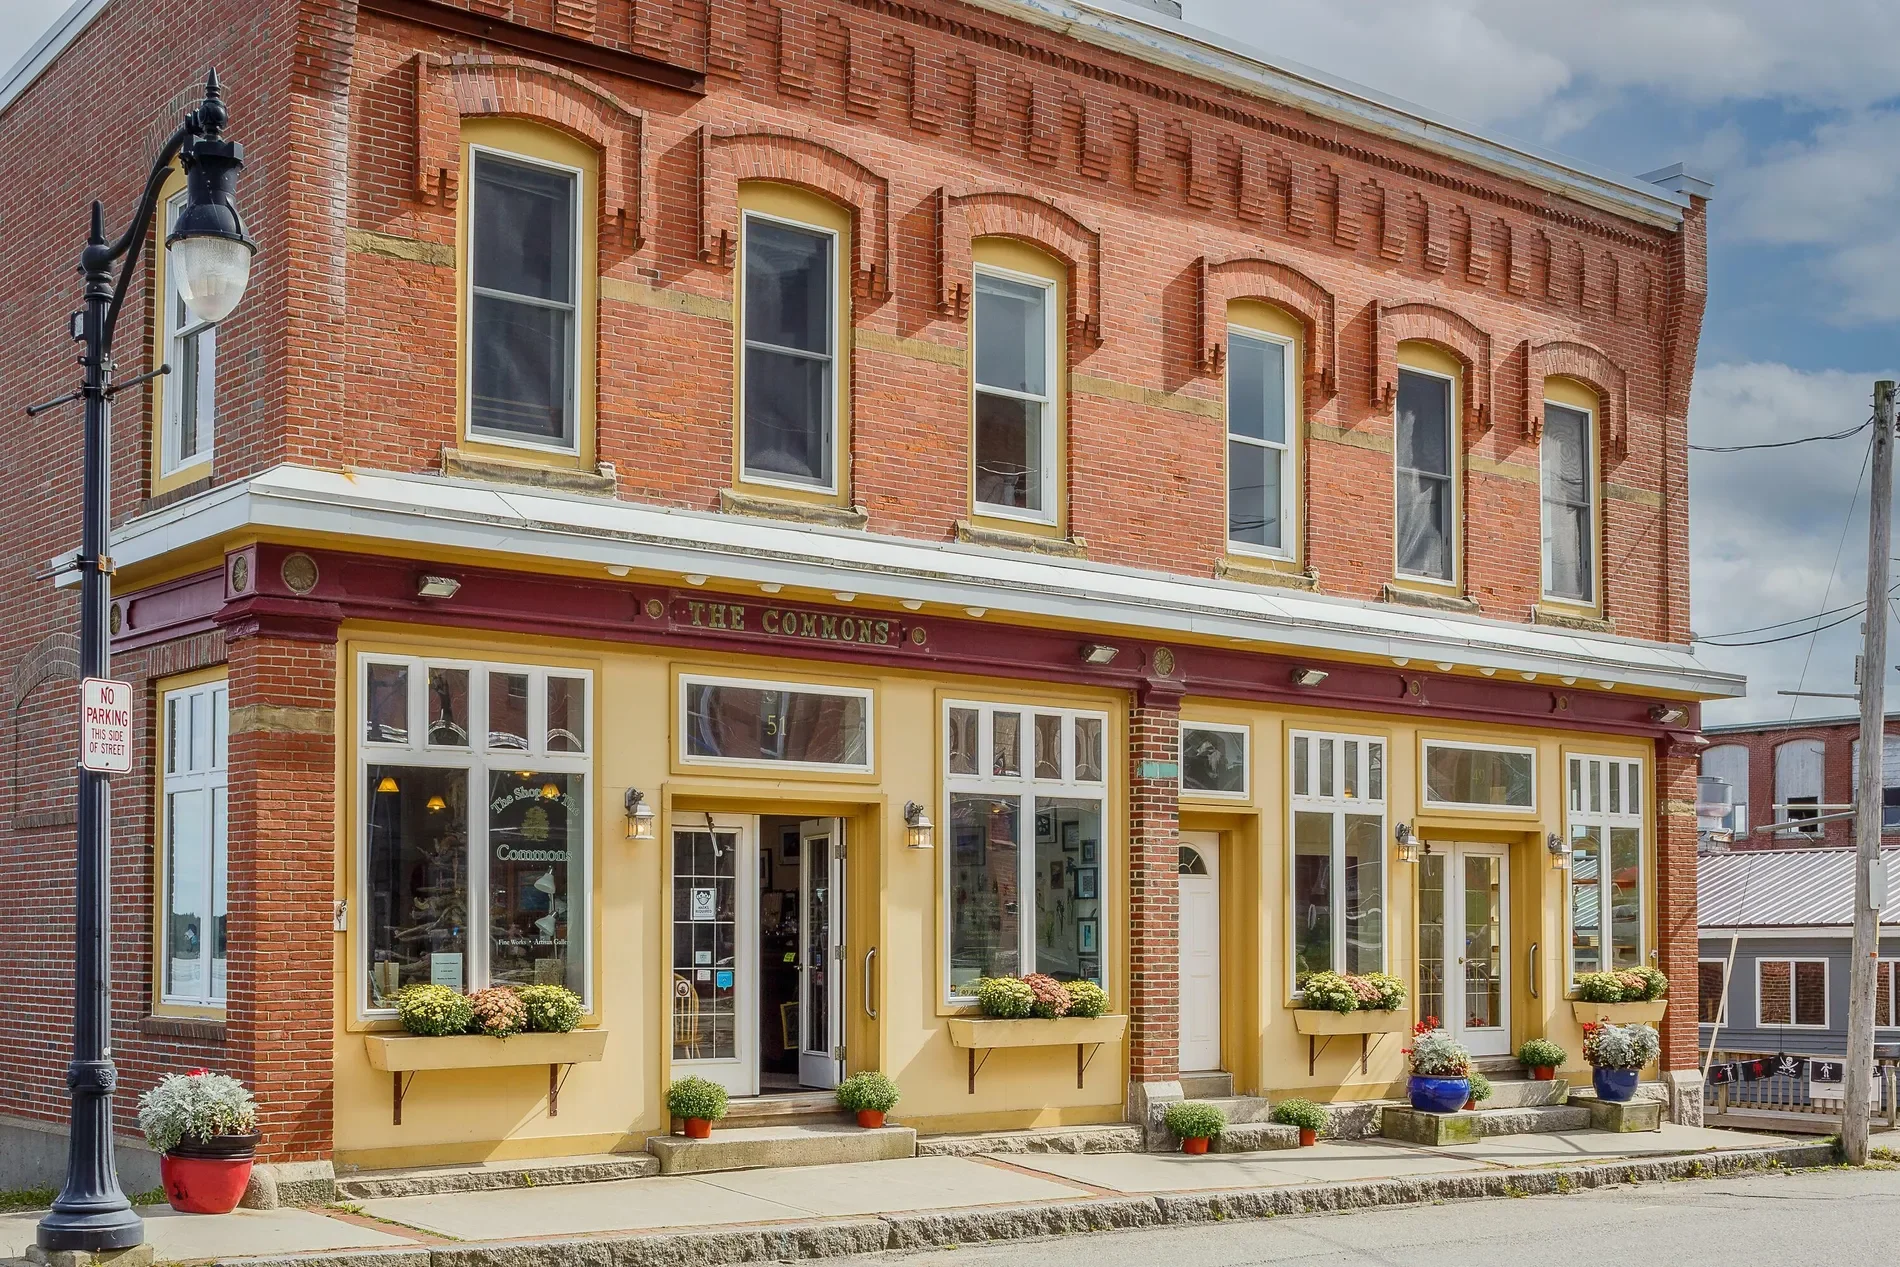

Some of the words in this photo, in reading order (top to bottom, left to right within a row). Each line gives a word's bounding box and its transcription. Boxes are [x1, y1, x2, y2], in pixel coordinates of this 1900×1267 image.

[688, 600, 745, 631] THE
[762, 609, 889, 645] COMMONS
[101, 687, 115, 705] NO
[86, 707, 128, 727] PARKING
[766, 714, 787, 736] 51
[91, 727, 106, 741] THIS
[108, 729, 124, 742] SIDE
[89, 741, 99, 754] OF
[101, 742, 125, 756] STREET
[1471, 768, 1486, 786] 49
[490, 795, 514, 814] The
[513, 785, 543, 802] Shop
[561, 792, 580, 817] The
[496, 843, 573, 862] Commons
[498, 938, 510, 946] Fine
[511, 938, 527, 946] Works
[533, 938, 552, 946] Artisan
